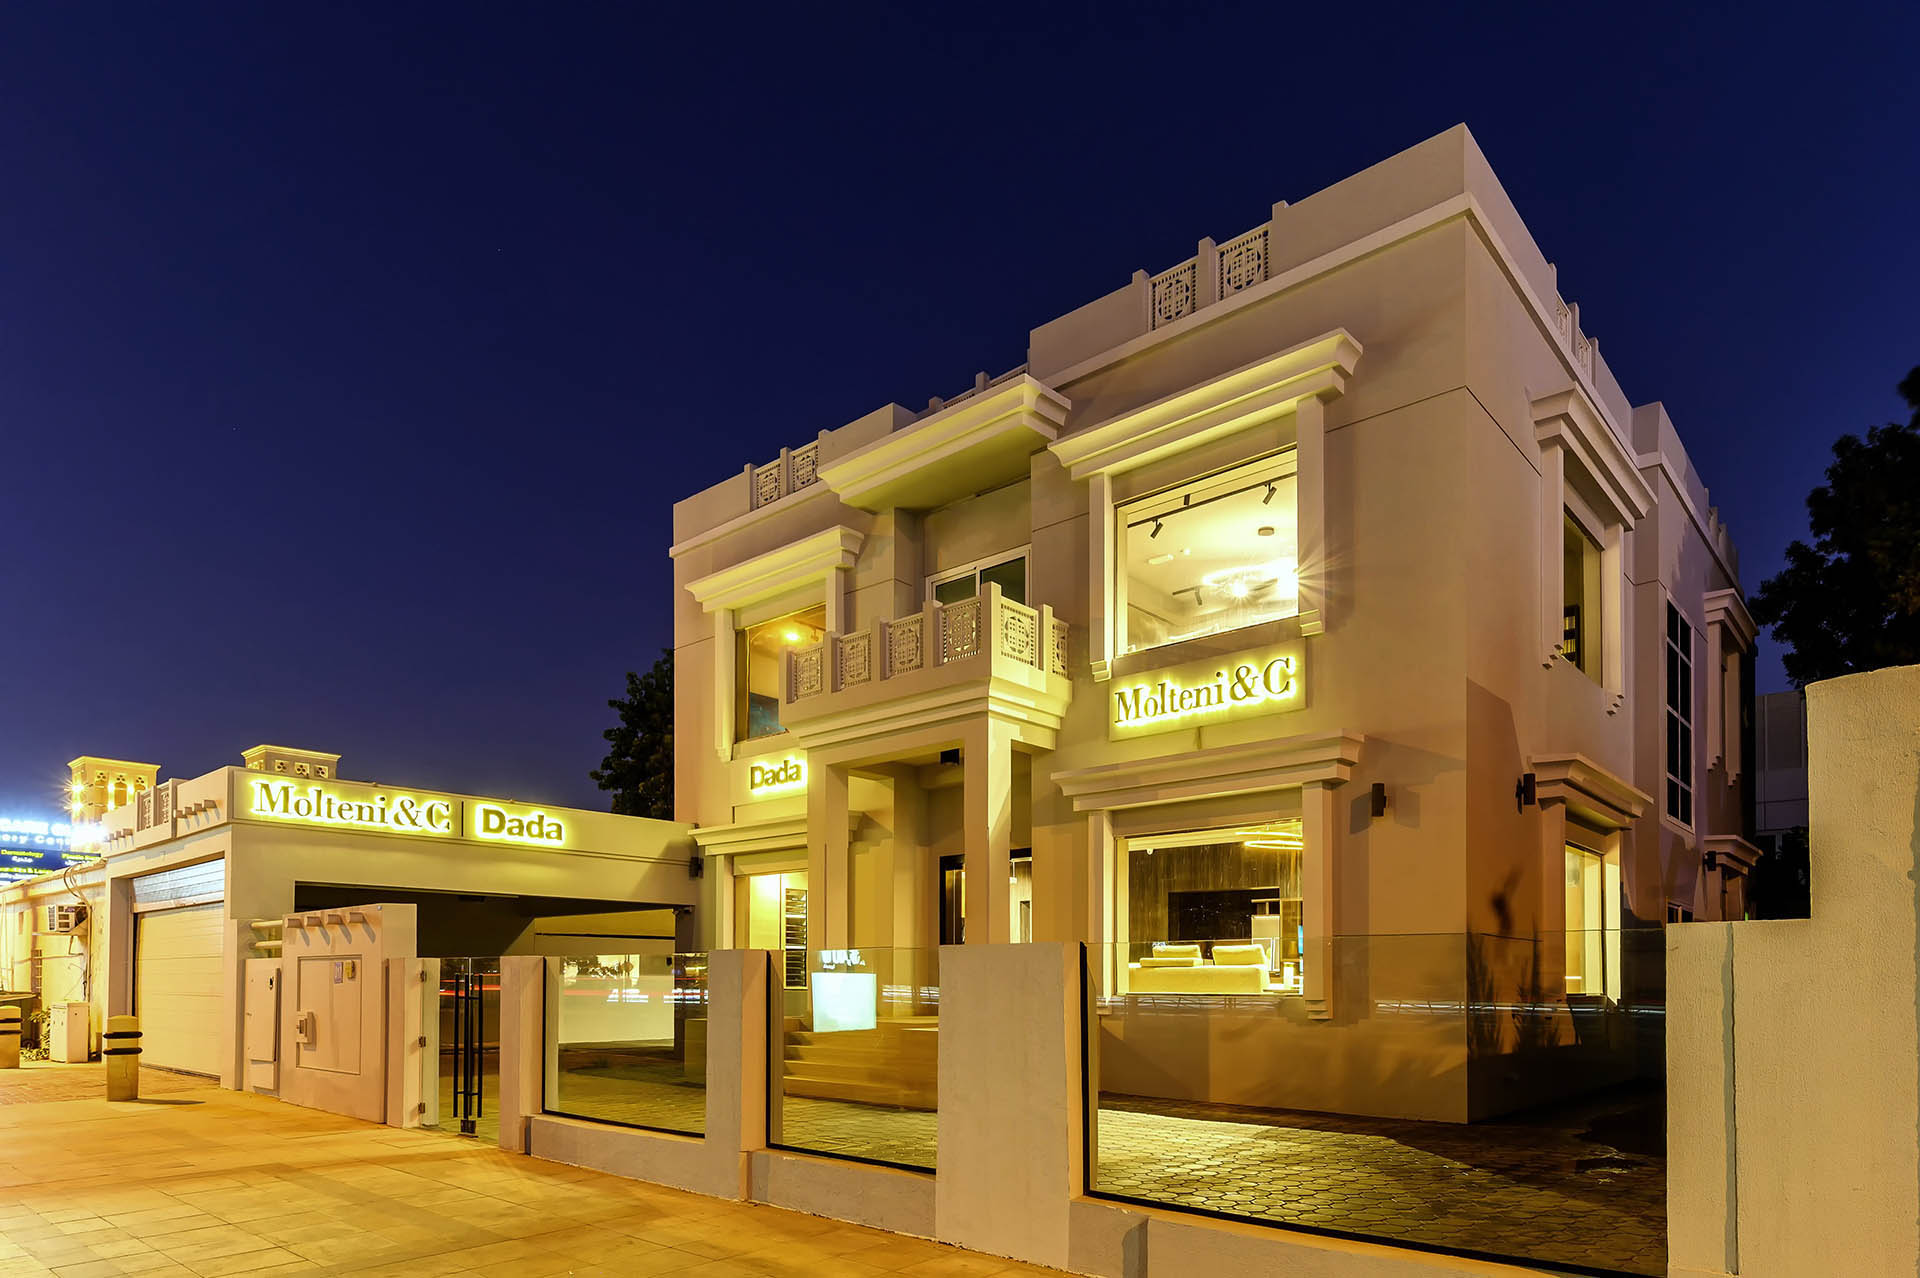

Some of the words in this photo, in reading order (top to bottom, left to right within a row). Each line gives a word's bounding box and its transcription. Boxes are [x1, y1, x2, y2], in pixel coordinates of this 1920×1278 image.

[1114, 657, 1290, 724] Molteni&C
[750, 760, 801, 789] Dada
[255, 782, 451, 832] Molteni&C
[482, 808, 564, 841] Dada
